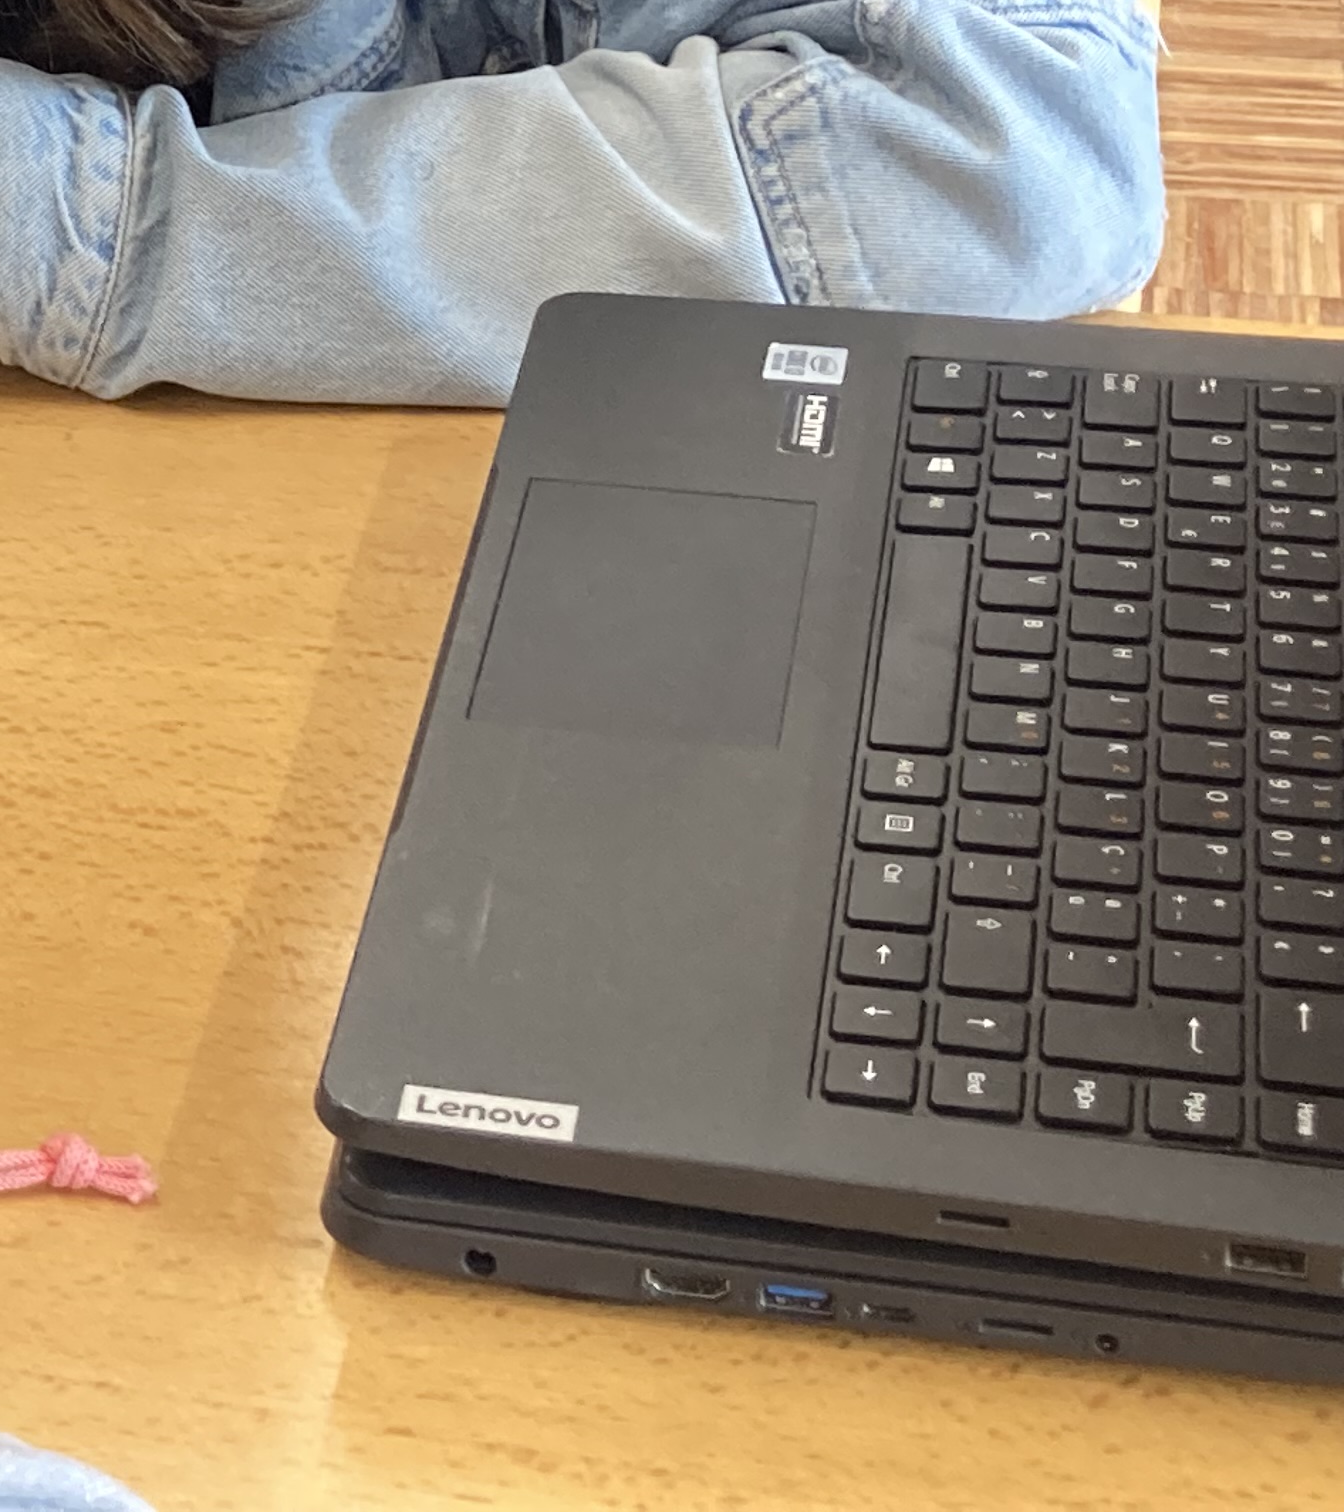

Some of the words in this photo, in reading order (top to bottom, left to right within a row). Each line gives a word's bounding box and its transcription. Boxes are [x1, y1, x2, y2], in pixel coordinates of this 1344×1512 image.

[799, 394, 828, 447] HDMI
[966, 1071, 987, 1095] End
[1072, 1079, 1097, 1110] PgDn
[415, 1093, 561, 1130] Lenovo
